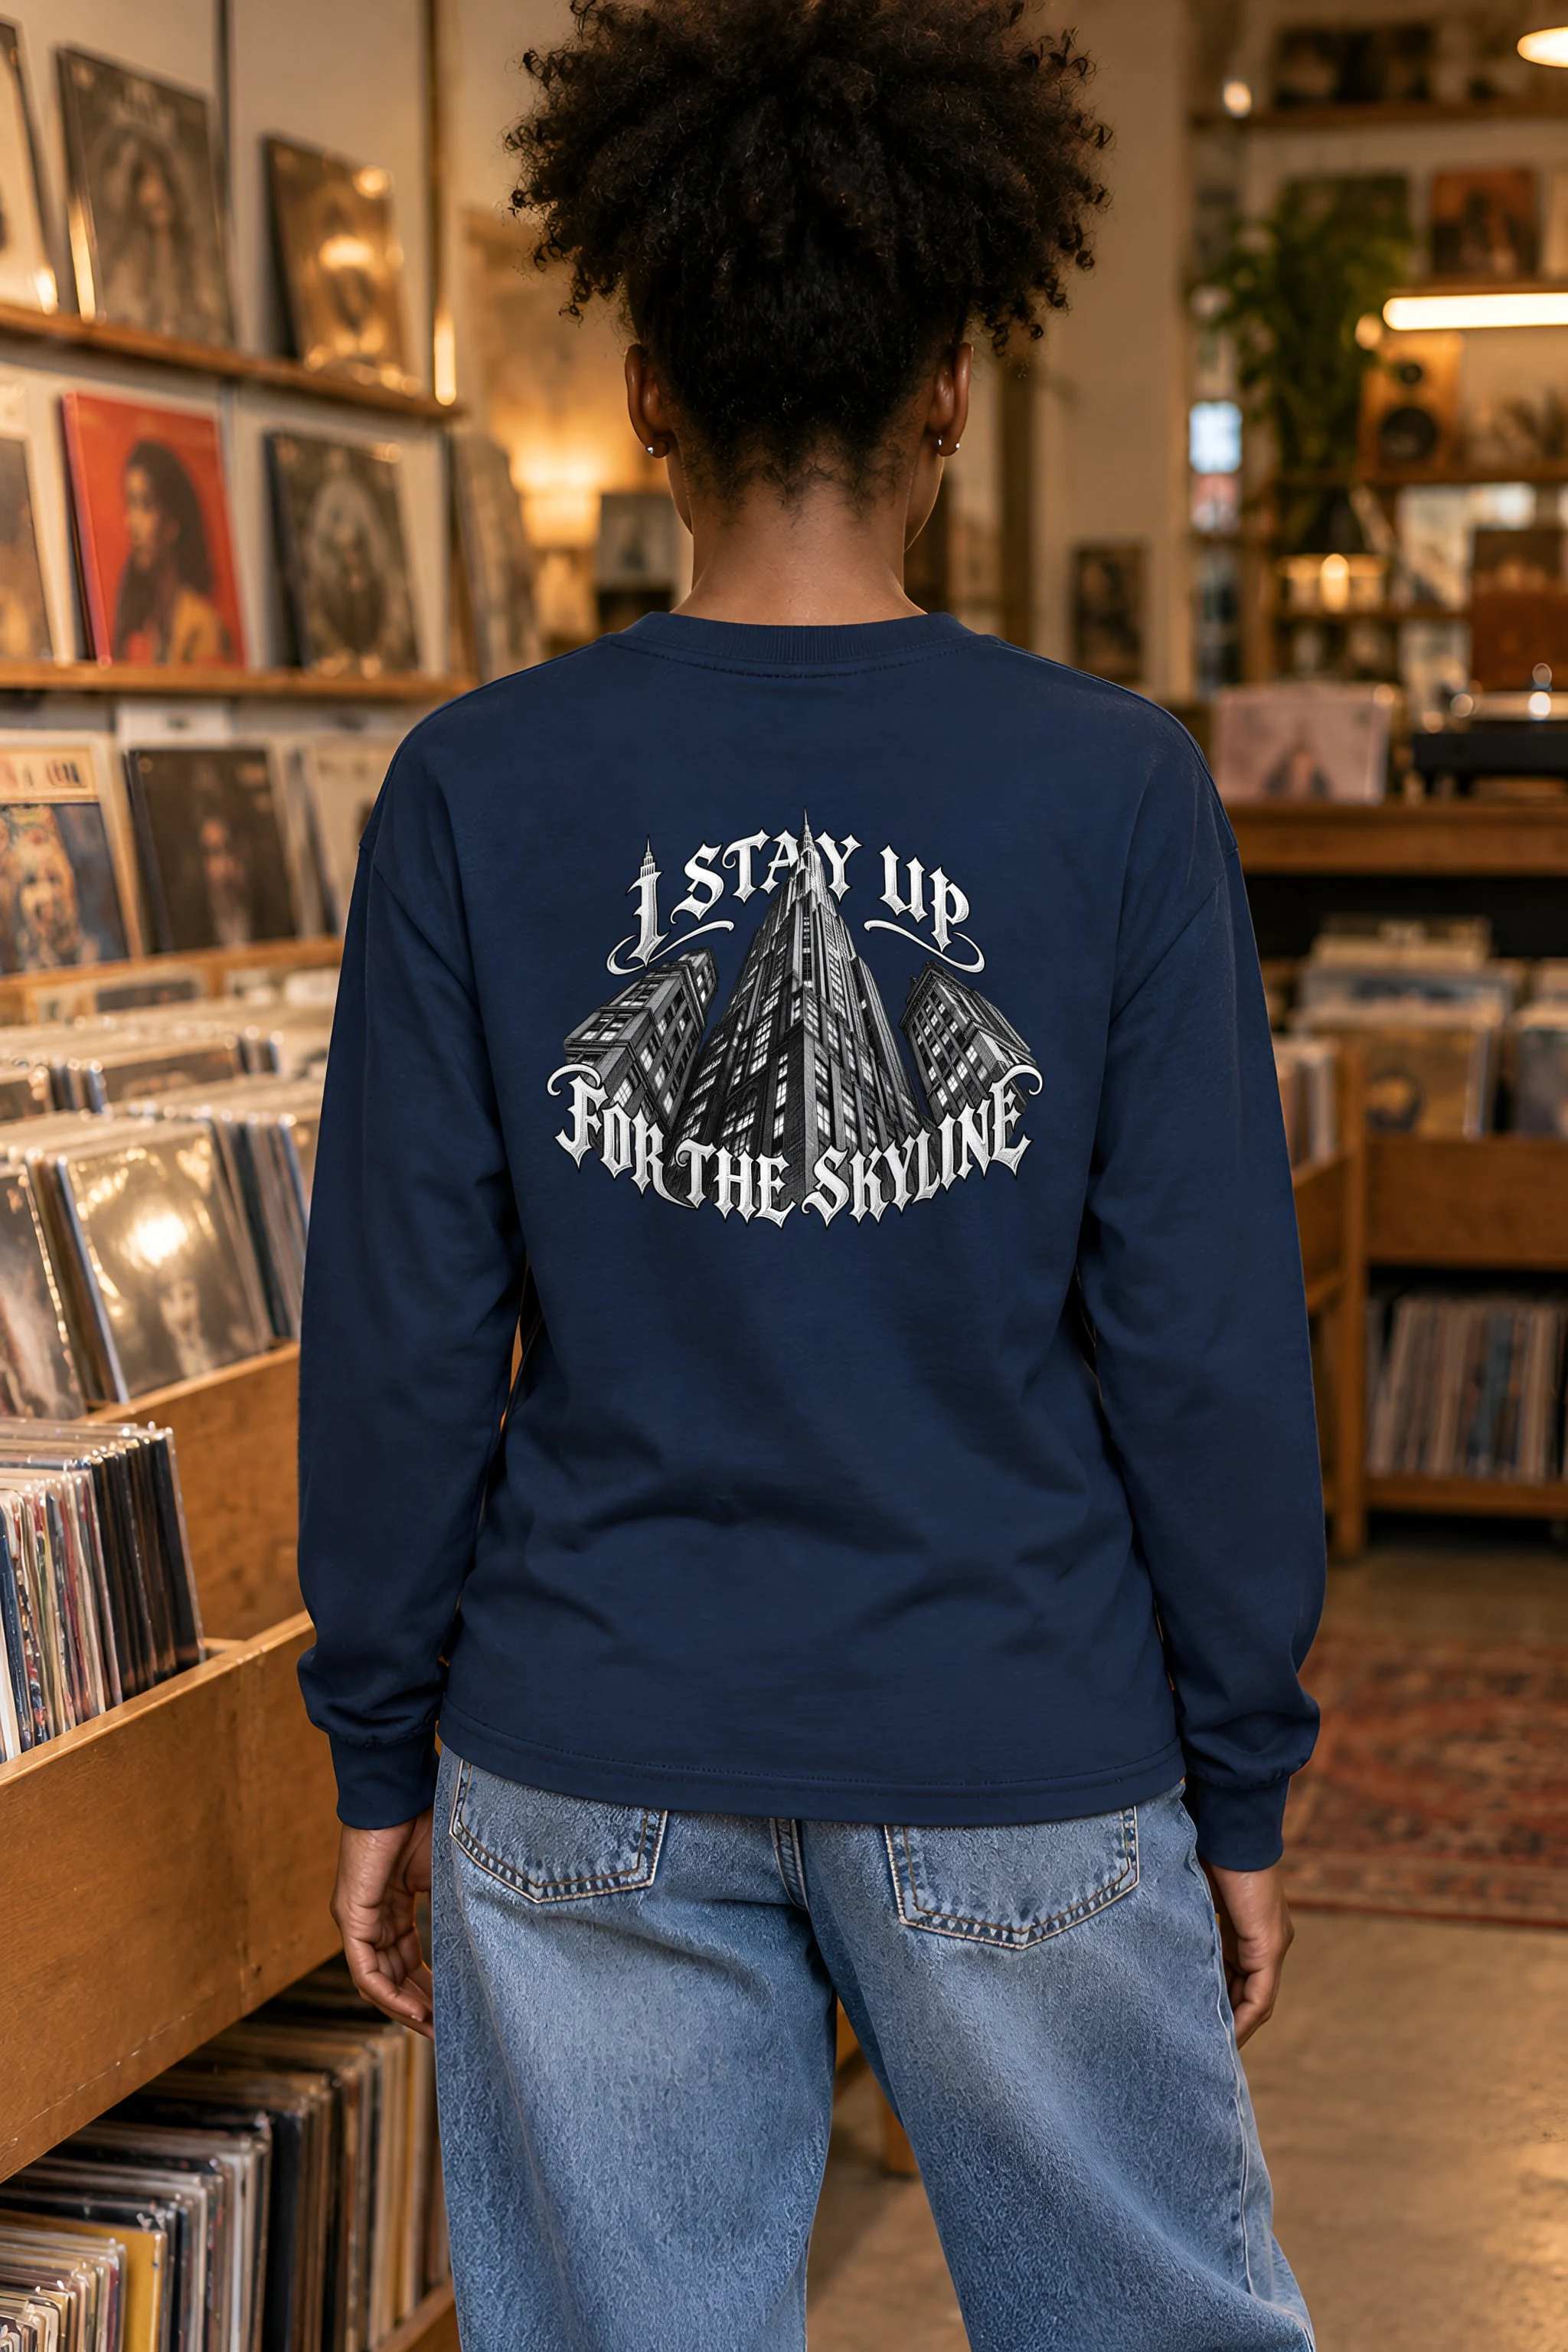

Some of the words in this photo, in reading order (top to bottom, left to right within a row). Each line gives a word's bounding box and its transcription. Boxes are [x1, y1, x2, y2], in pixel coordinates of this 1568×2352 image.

[624, 835, 671, 967] I
[670, 828, 862, 923] STAY
[546, 1063, 694, 1209] FOR
[675, 1138, 797, 1229] THE
[801, 1063, 1044, 1227] SKYLINE
